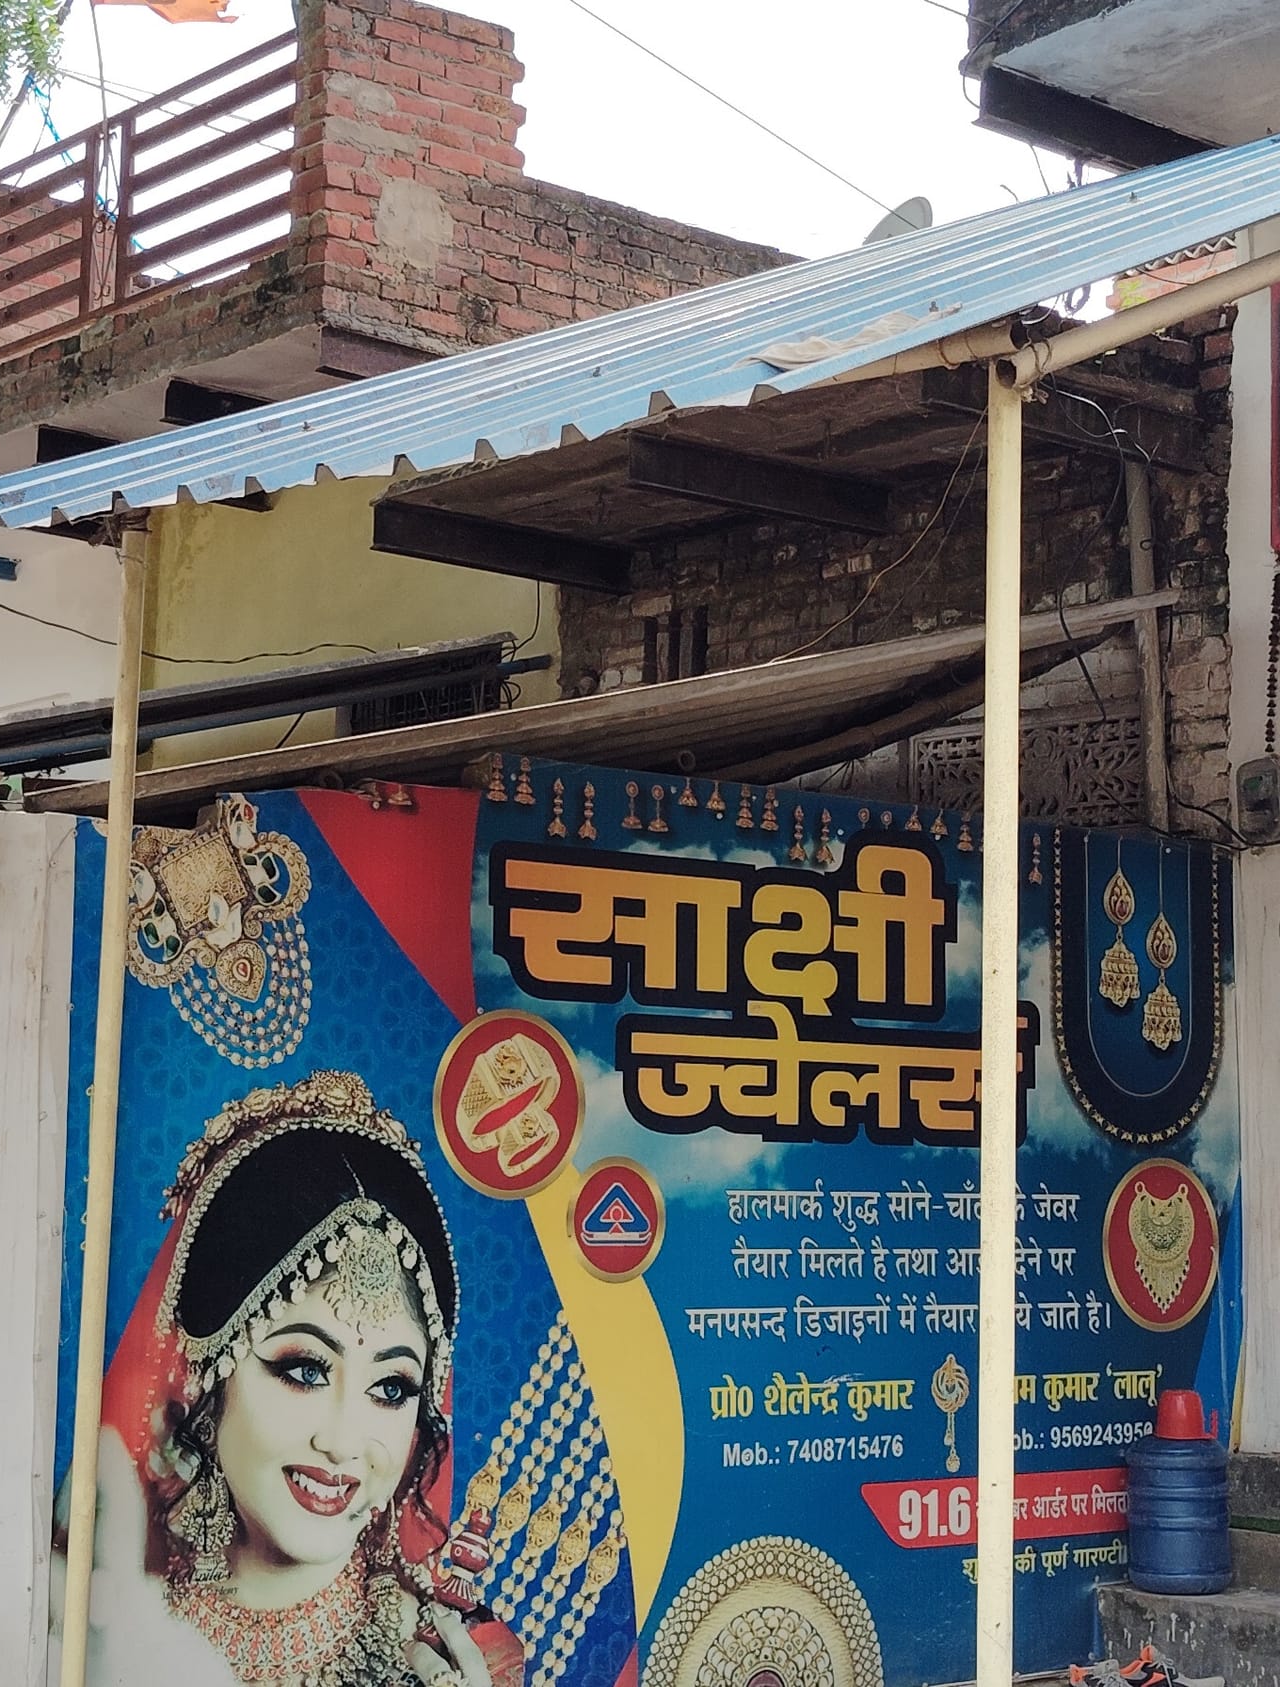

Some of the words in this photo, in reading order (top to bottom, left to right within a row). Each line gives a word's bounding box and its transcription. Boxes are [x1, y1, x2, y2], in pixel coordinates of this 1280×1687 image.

[503, 843, 946, 1017] साक्षी
[725, 1178, 825, 1225] हालमार्क
[830, 1190, 881, 1233] शुद्ध
[1031, 1182, 1080, 1223] जेवर
[731, 1235, 792, 1280] तैयार
[798, 1236, 865, 1279] मिलते
[870, 1235, 890, 1283] है
[892, 1248, 939, 1278] तथा
[1048, 1248, 1076, 1277] पर
[685, 1306, 788, 1343] मनपसन्द
[793, 1292, 891, 1345] डिजाइनों
[896, 1292, 917, 1336] में
[923, 1291, 979, 1335] तैयार
[1037, 1291, 1081, 1331] जाते
[764, 1372, 840, 1416] शैलेन्द्र
[846, 1379, 915, 1422] कुमार
[1043, 1372, 1101, 1412] कुमार
[787, 1434, 904, 1464] 7408715476
[1013, 1428, 1045, 1451] ob.:
[898, 1486, 971, 1540] 91.6
[1032, 1487, 1068, 1519] आर्डर
[1071, 1494, 1087, 1515] पर
[1014, 1546, 1035, 1575] की
[1041, 1543, 1069, 1578] पूर्ण
